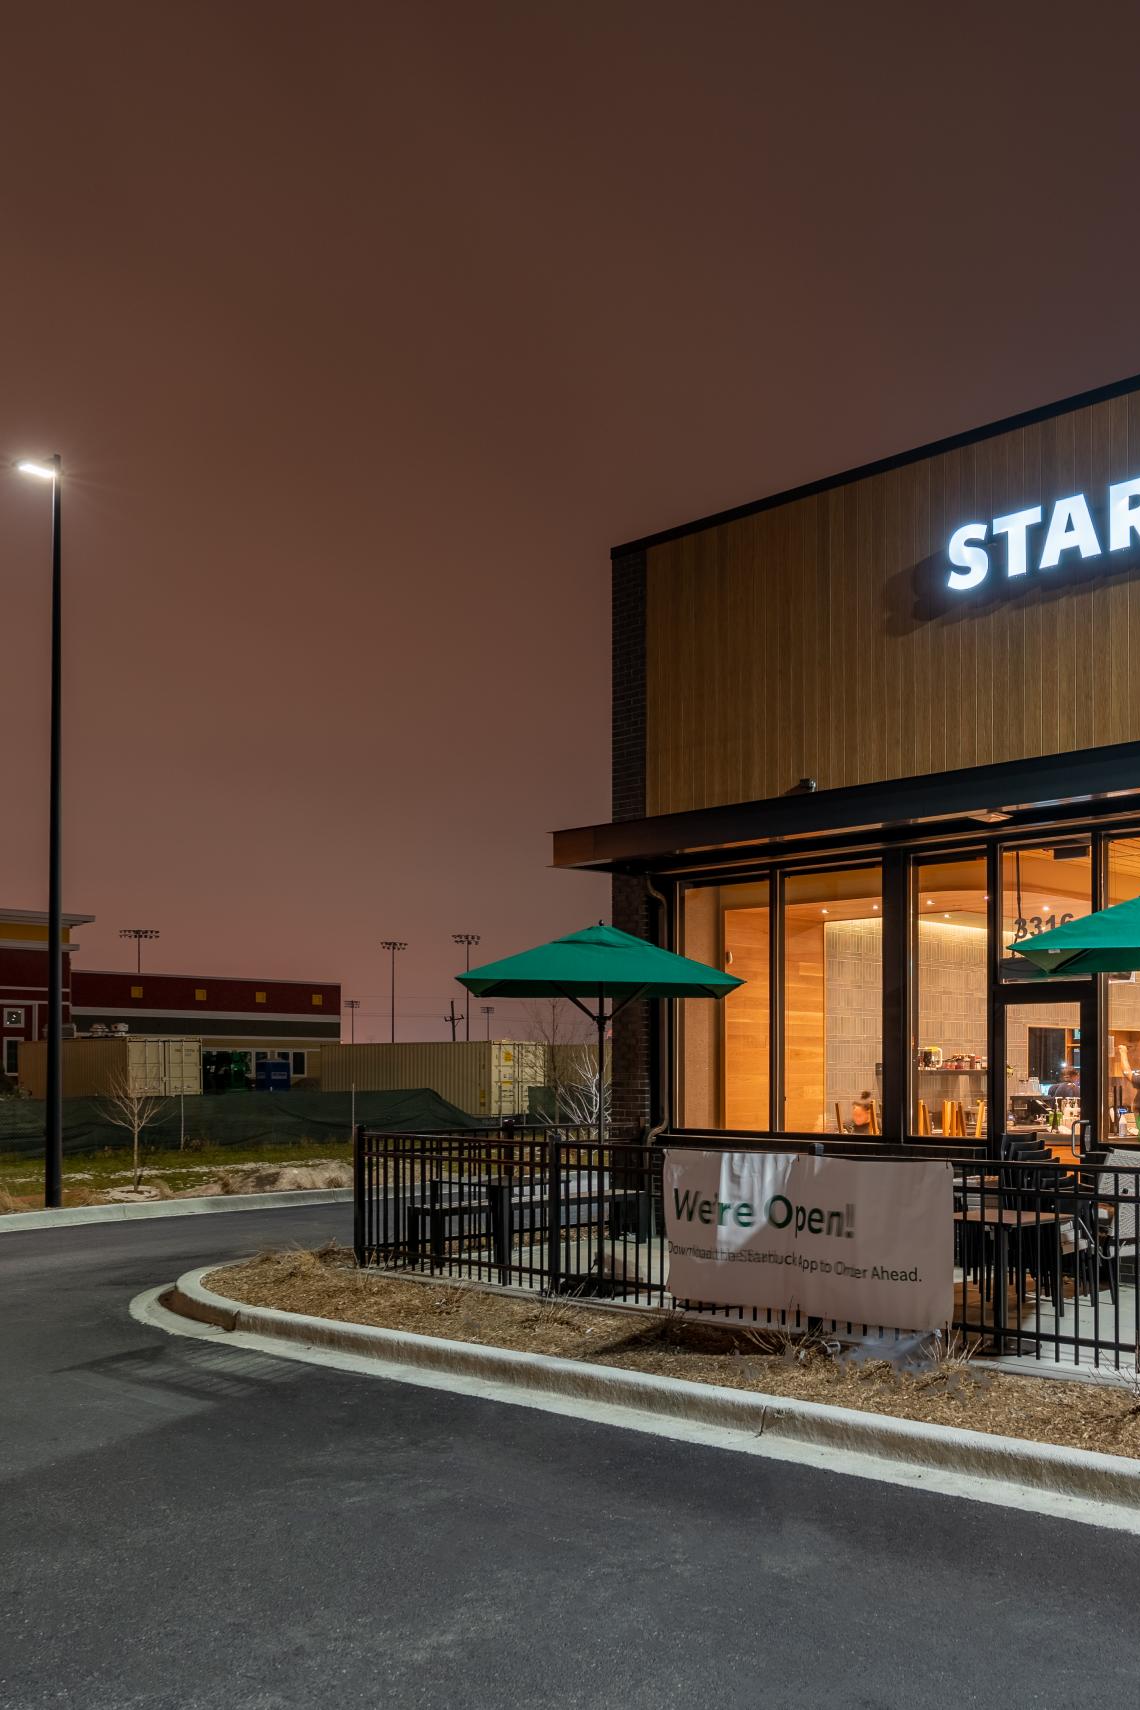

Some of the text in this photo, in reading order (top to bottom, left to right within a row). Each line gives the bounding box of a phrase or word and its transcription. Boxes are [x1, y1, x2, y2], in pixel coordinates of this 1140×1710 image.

[674, 1187, 856, 1239] We're Open!
[871, 1265, 922, 1282] Ahead.
